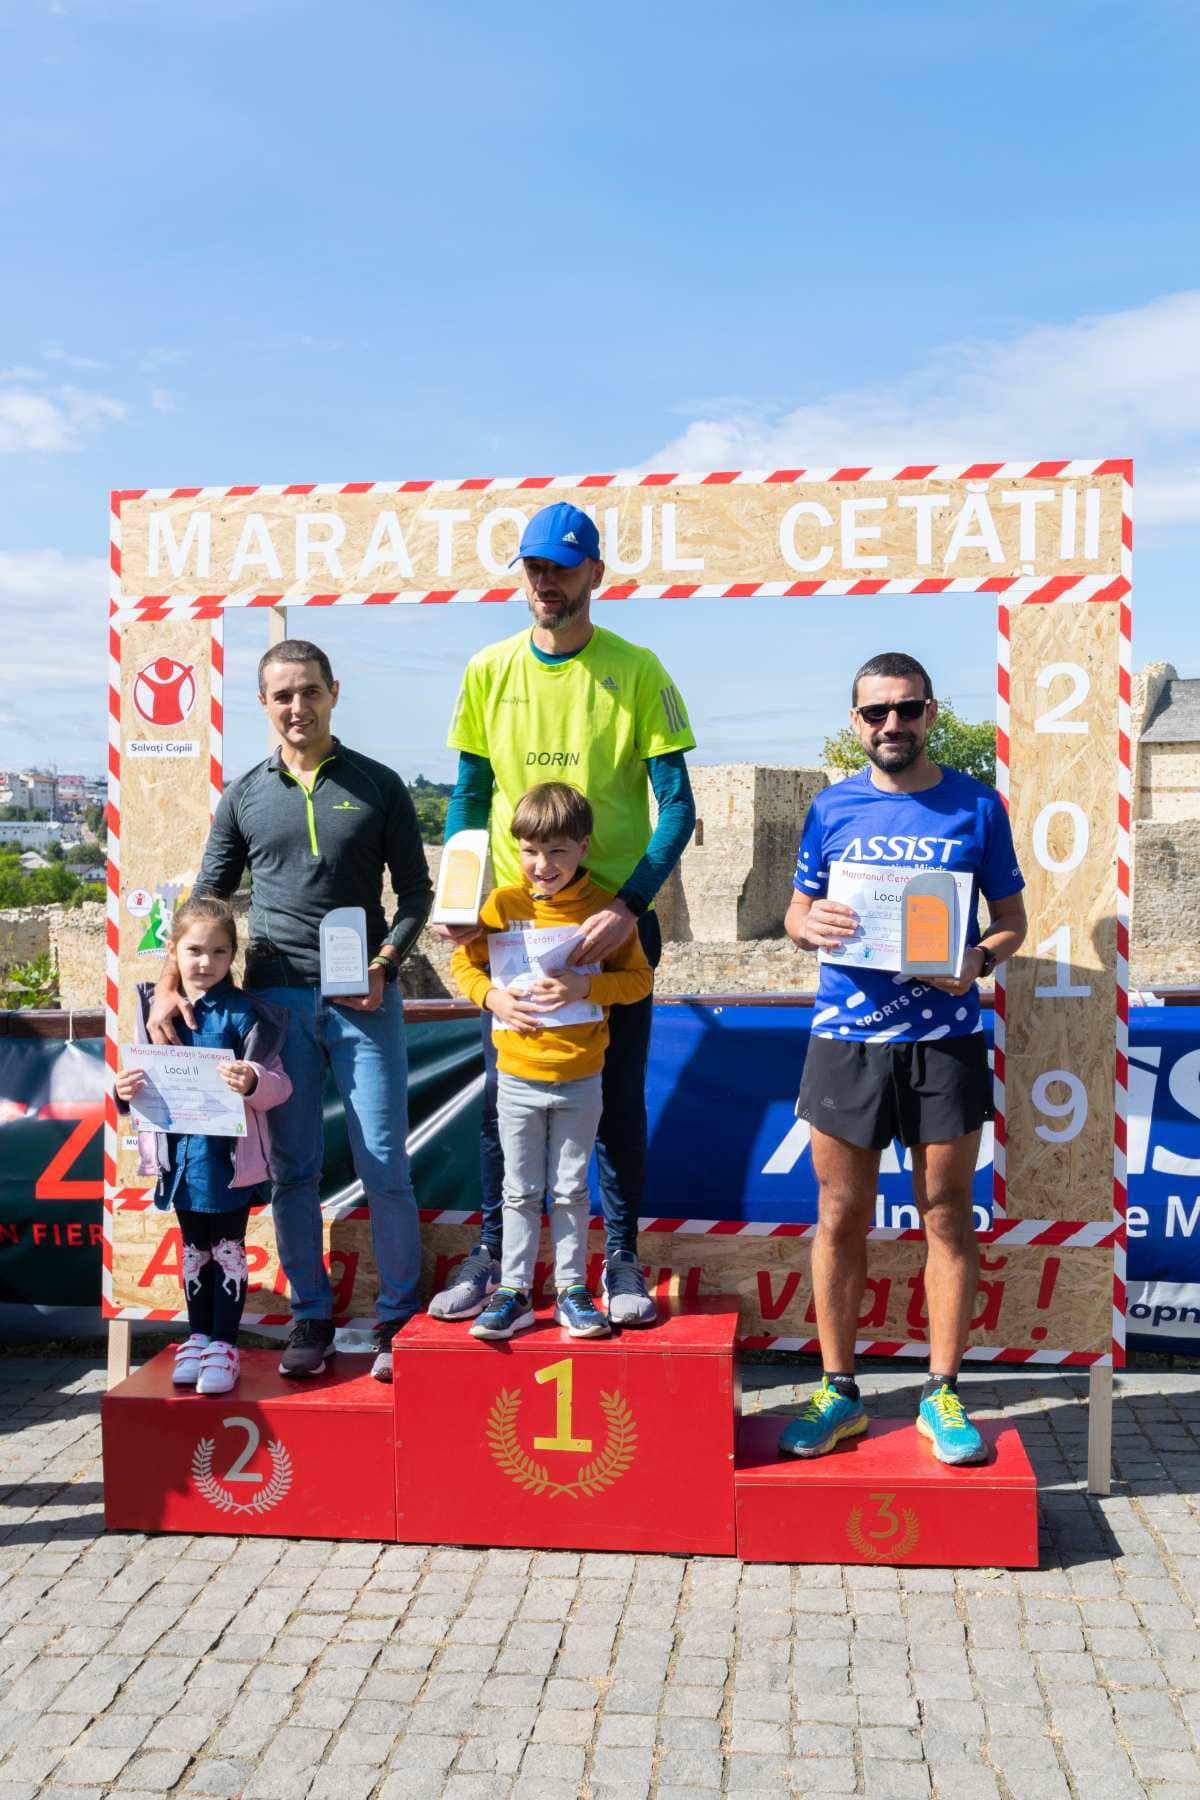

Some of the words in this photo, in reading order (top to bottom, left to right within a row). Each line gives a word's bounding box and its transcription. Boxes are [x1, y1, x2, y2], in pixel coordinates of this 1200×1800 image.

[148, 502, 704, 579] MARATOUL
[779, 482, 1100, 577] CETĂȚII
[165, 743, 193, 753] Copiii
[525, 751, 580, 766] DORIN
[874, 888, 902, 902] Locu
[855, 995, 910, 1027] SPORTS
[164, 1065, 190, 1075] Locul
[533, 1358, 593, 1453] 1
[222, 1416, 263, 1483] 2
[868, 1493, 899, 1539] 3
